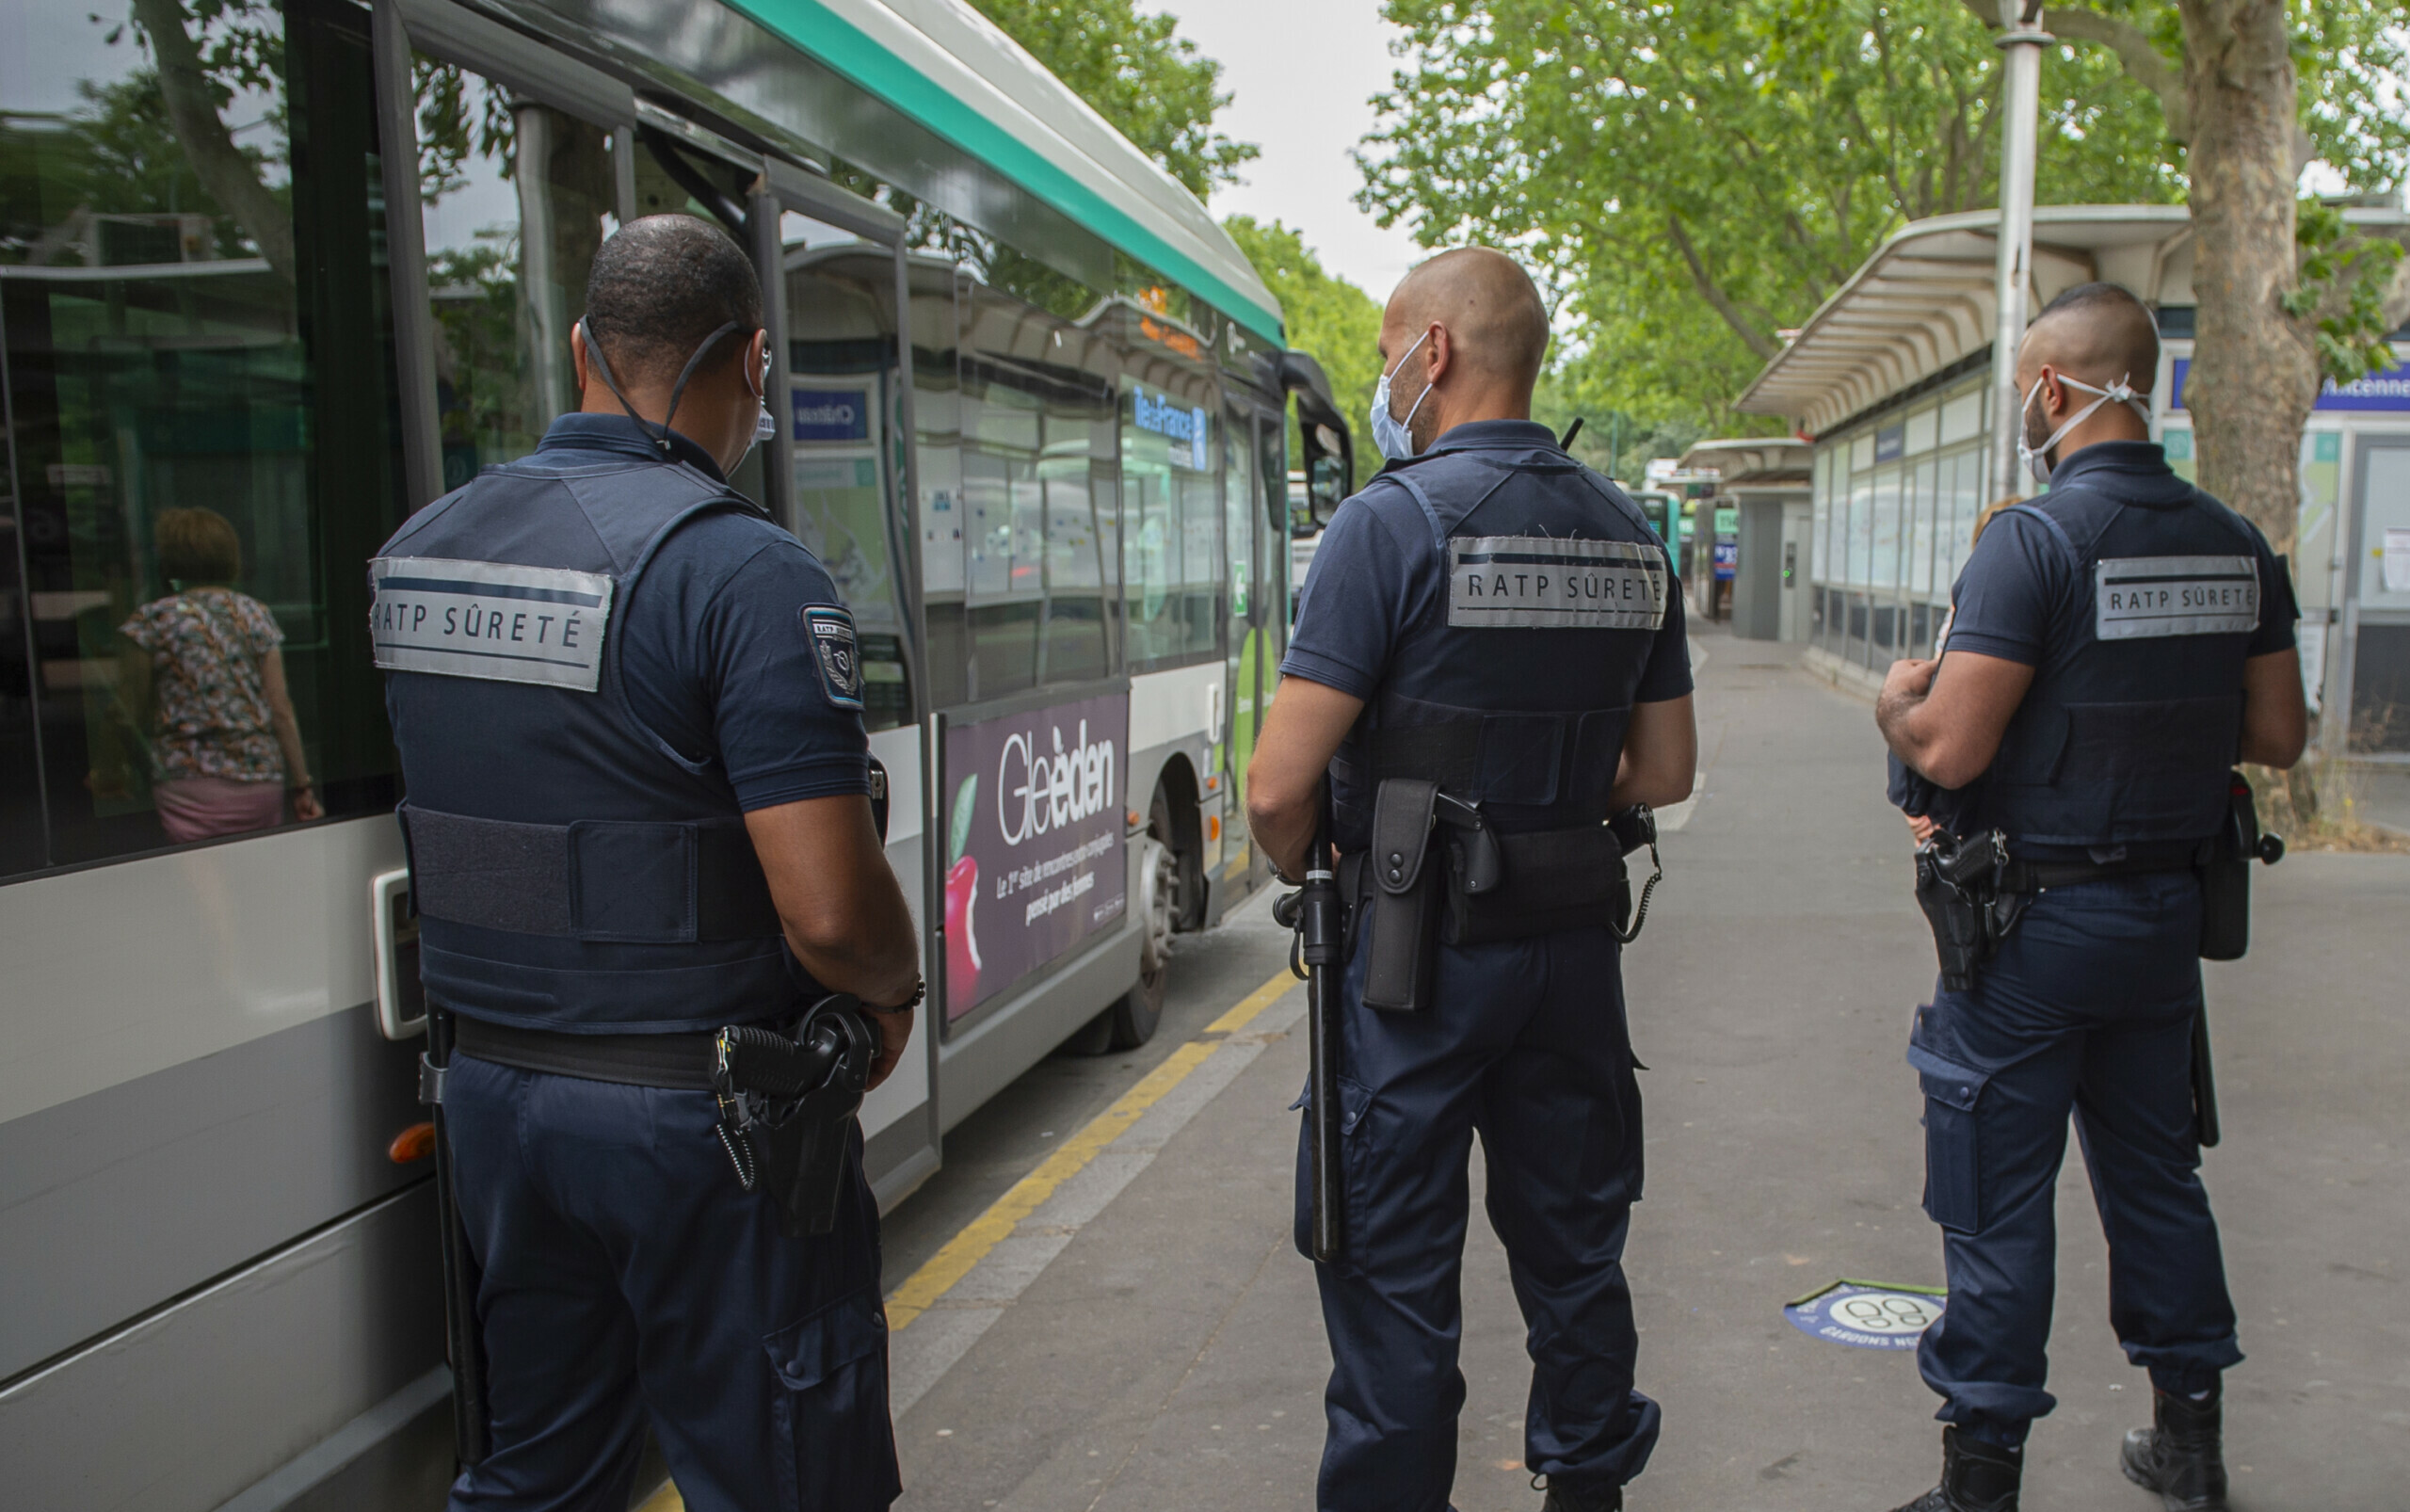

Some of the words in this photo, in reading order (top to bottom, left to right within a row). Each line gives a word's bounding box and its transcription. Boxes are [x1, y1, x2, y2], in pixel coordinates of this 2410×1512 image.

[1468, 574, 1549, 597] RATP
[1567, 572, 1662, 602] SÛRETÉ
[2111, 590, 2169, 610] RATP
[2182, 585, 2253, 607] SÛRETÉ
[373, 603, 426, 632] RATP
[443, 603, 582, 648] SÛRETÉ
